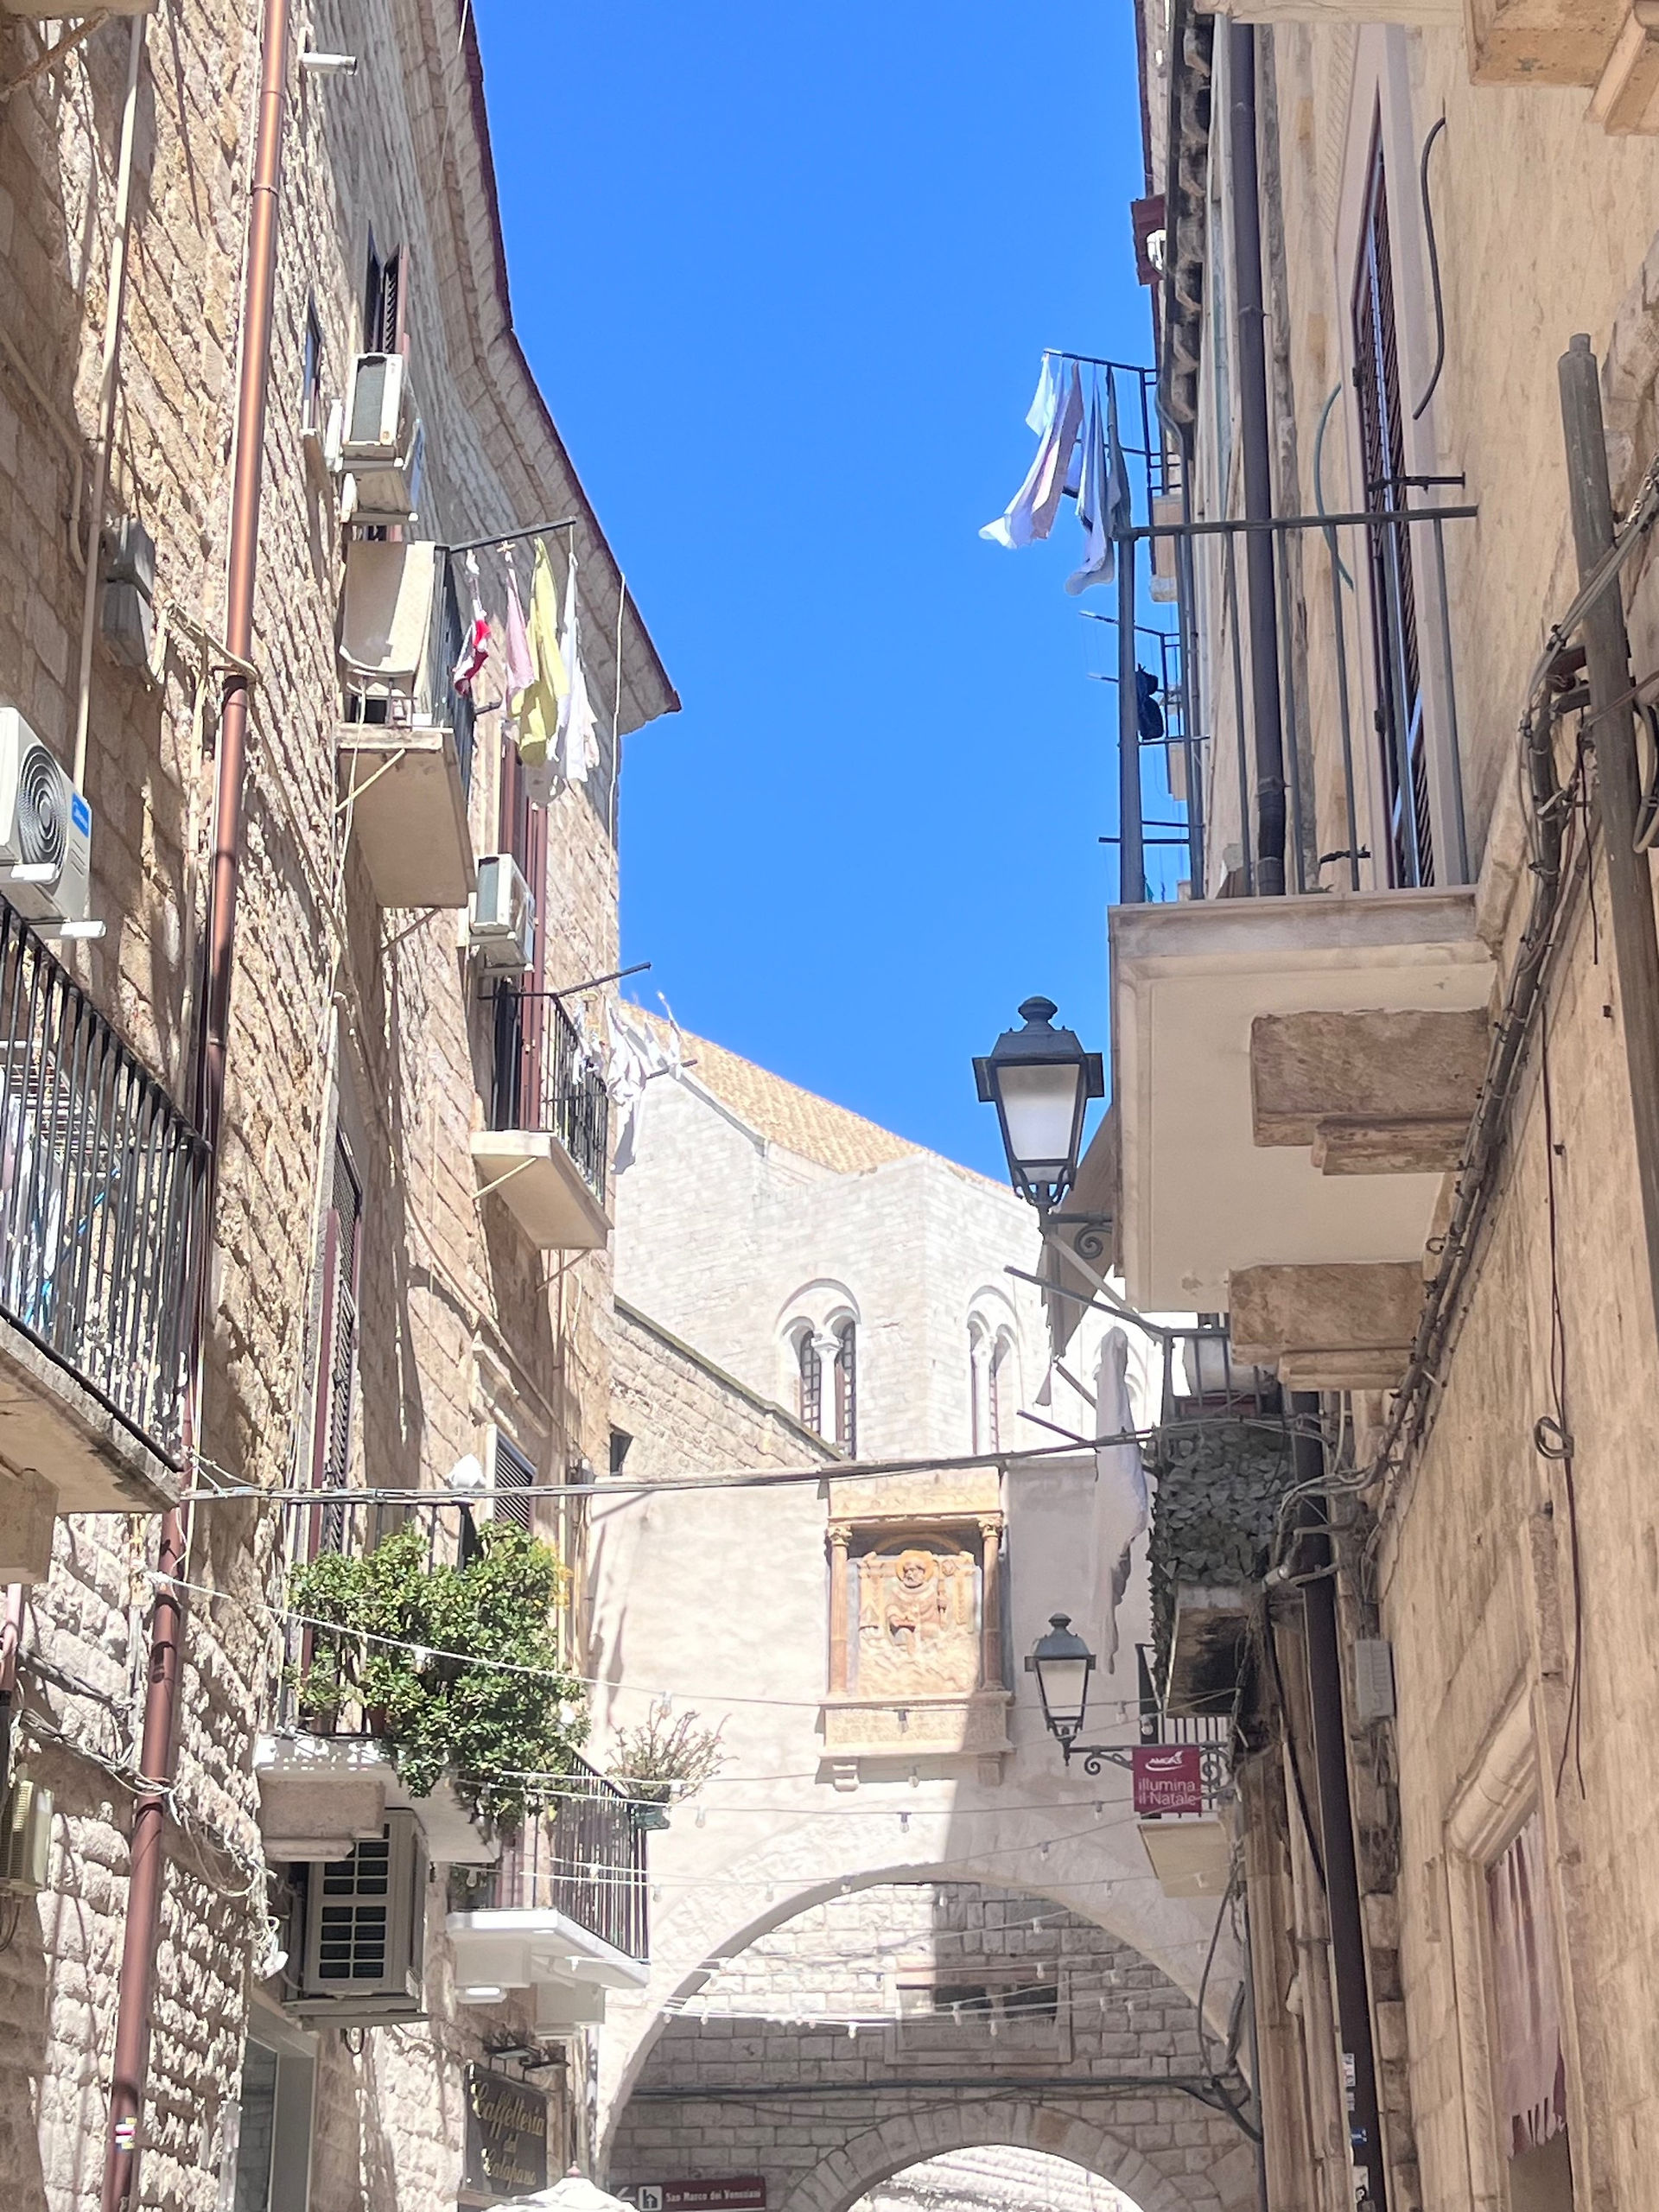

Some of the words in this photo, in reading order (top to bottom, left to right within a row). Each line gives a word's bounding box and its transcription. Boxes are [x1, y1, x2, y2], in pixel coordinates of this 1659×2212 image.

[1138, 1777, 1196, 1791] illumina
[1139, 1791, 1147, 1805] il
[1149, 1791, 1197, 1806] Natale
[665, 2192, 681, 2202] San
[683, 2191, 708, 2202] Marco
